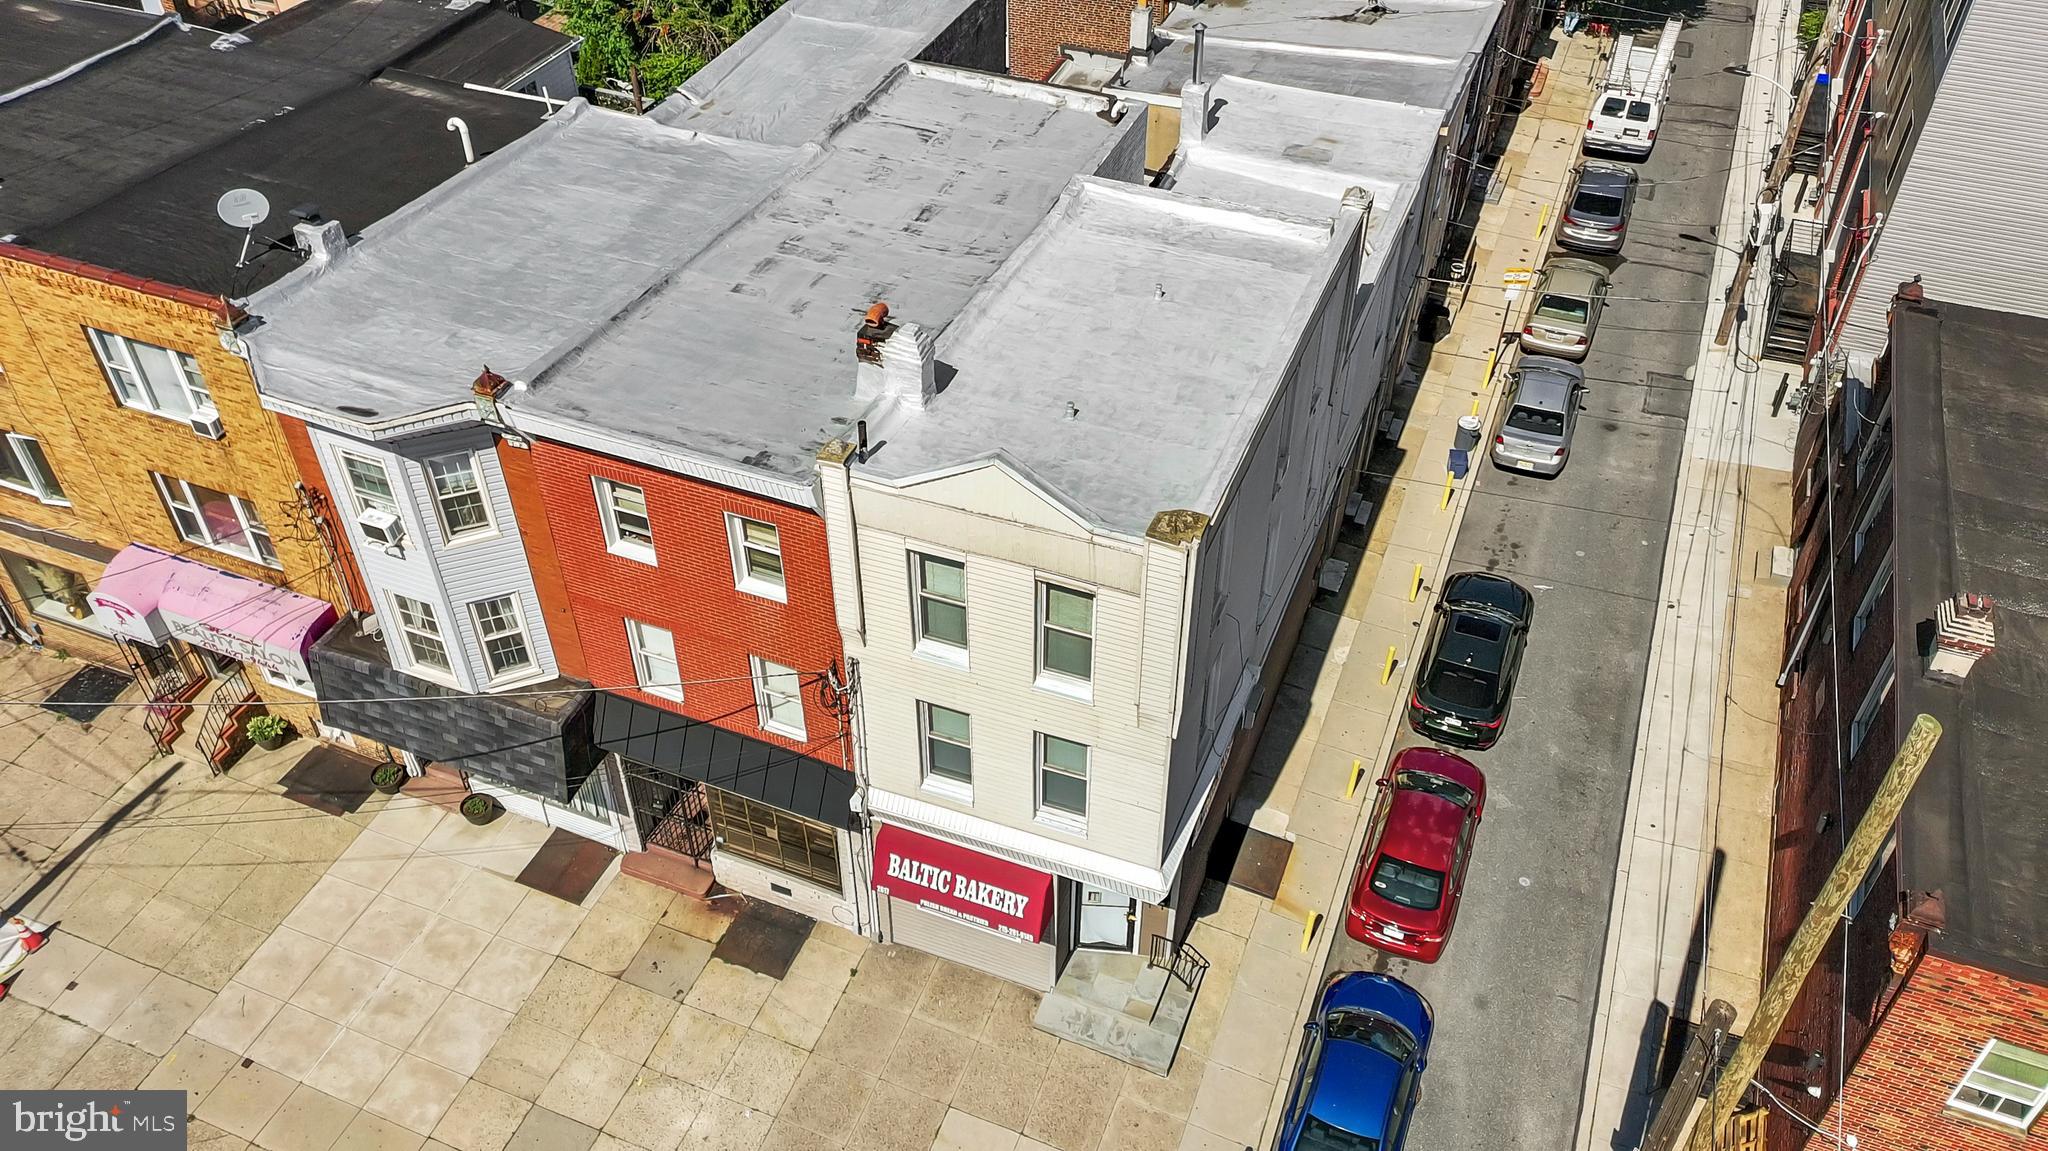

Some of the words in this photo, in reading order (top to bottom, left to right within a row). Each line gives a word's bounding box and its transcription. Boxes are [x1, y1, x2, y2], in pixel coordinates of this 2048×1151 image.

[171, 620, 233, 650] BEAUTY
[241, 644, 300, 672] SALON
[887, 853, 952, 894] BALTIC
[953, 873, 1030, 919] BAKERY
